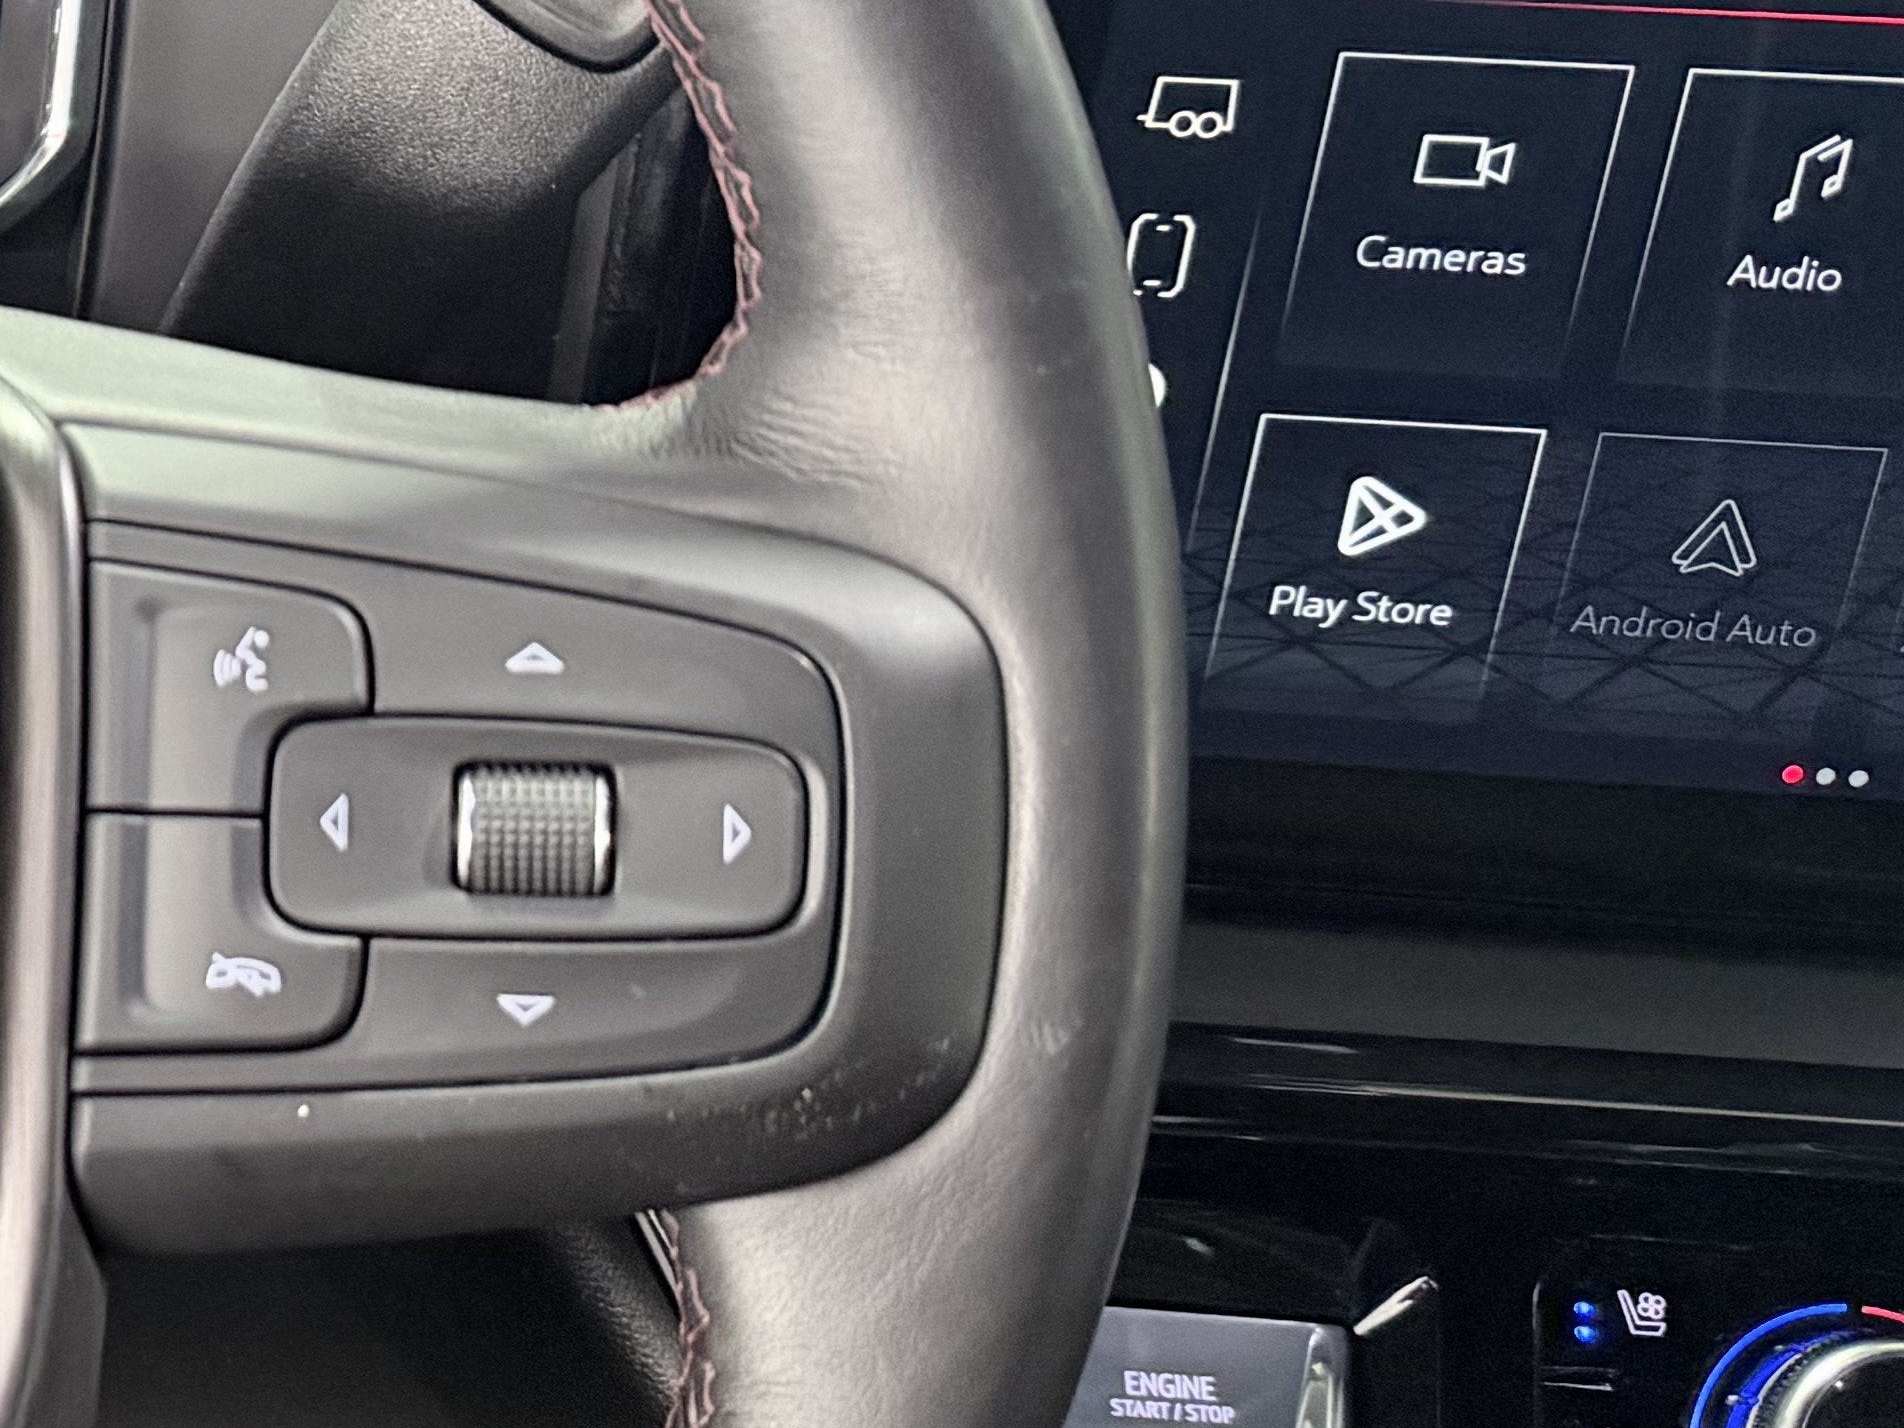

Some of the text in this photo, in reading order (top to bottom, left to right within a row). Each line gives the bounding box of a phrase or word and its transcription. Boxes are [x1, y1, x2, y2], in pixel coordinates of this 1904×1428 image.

[1356, 234, 1526, 276] Cameras
[1726, 254, 1842, 292] Audio
[1268, 584, 1454, 629] Play Store
[1568, 604, 1817, 648] Android Auto
[1121, 1369, 1218, 1402] ENGINE
